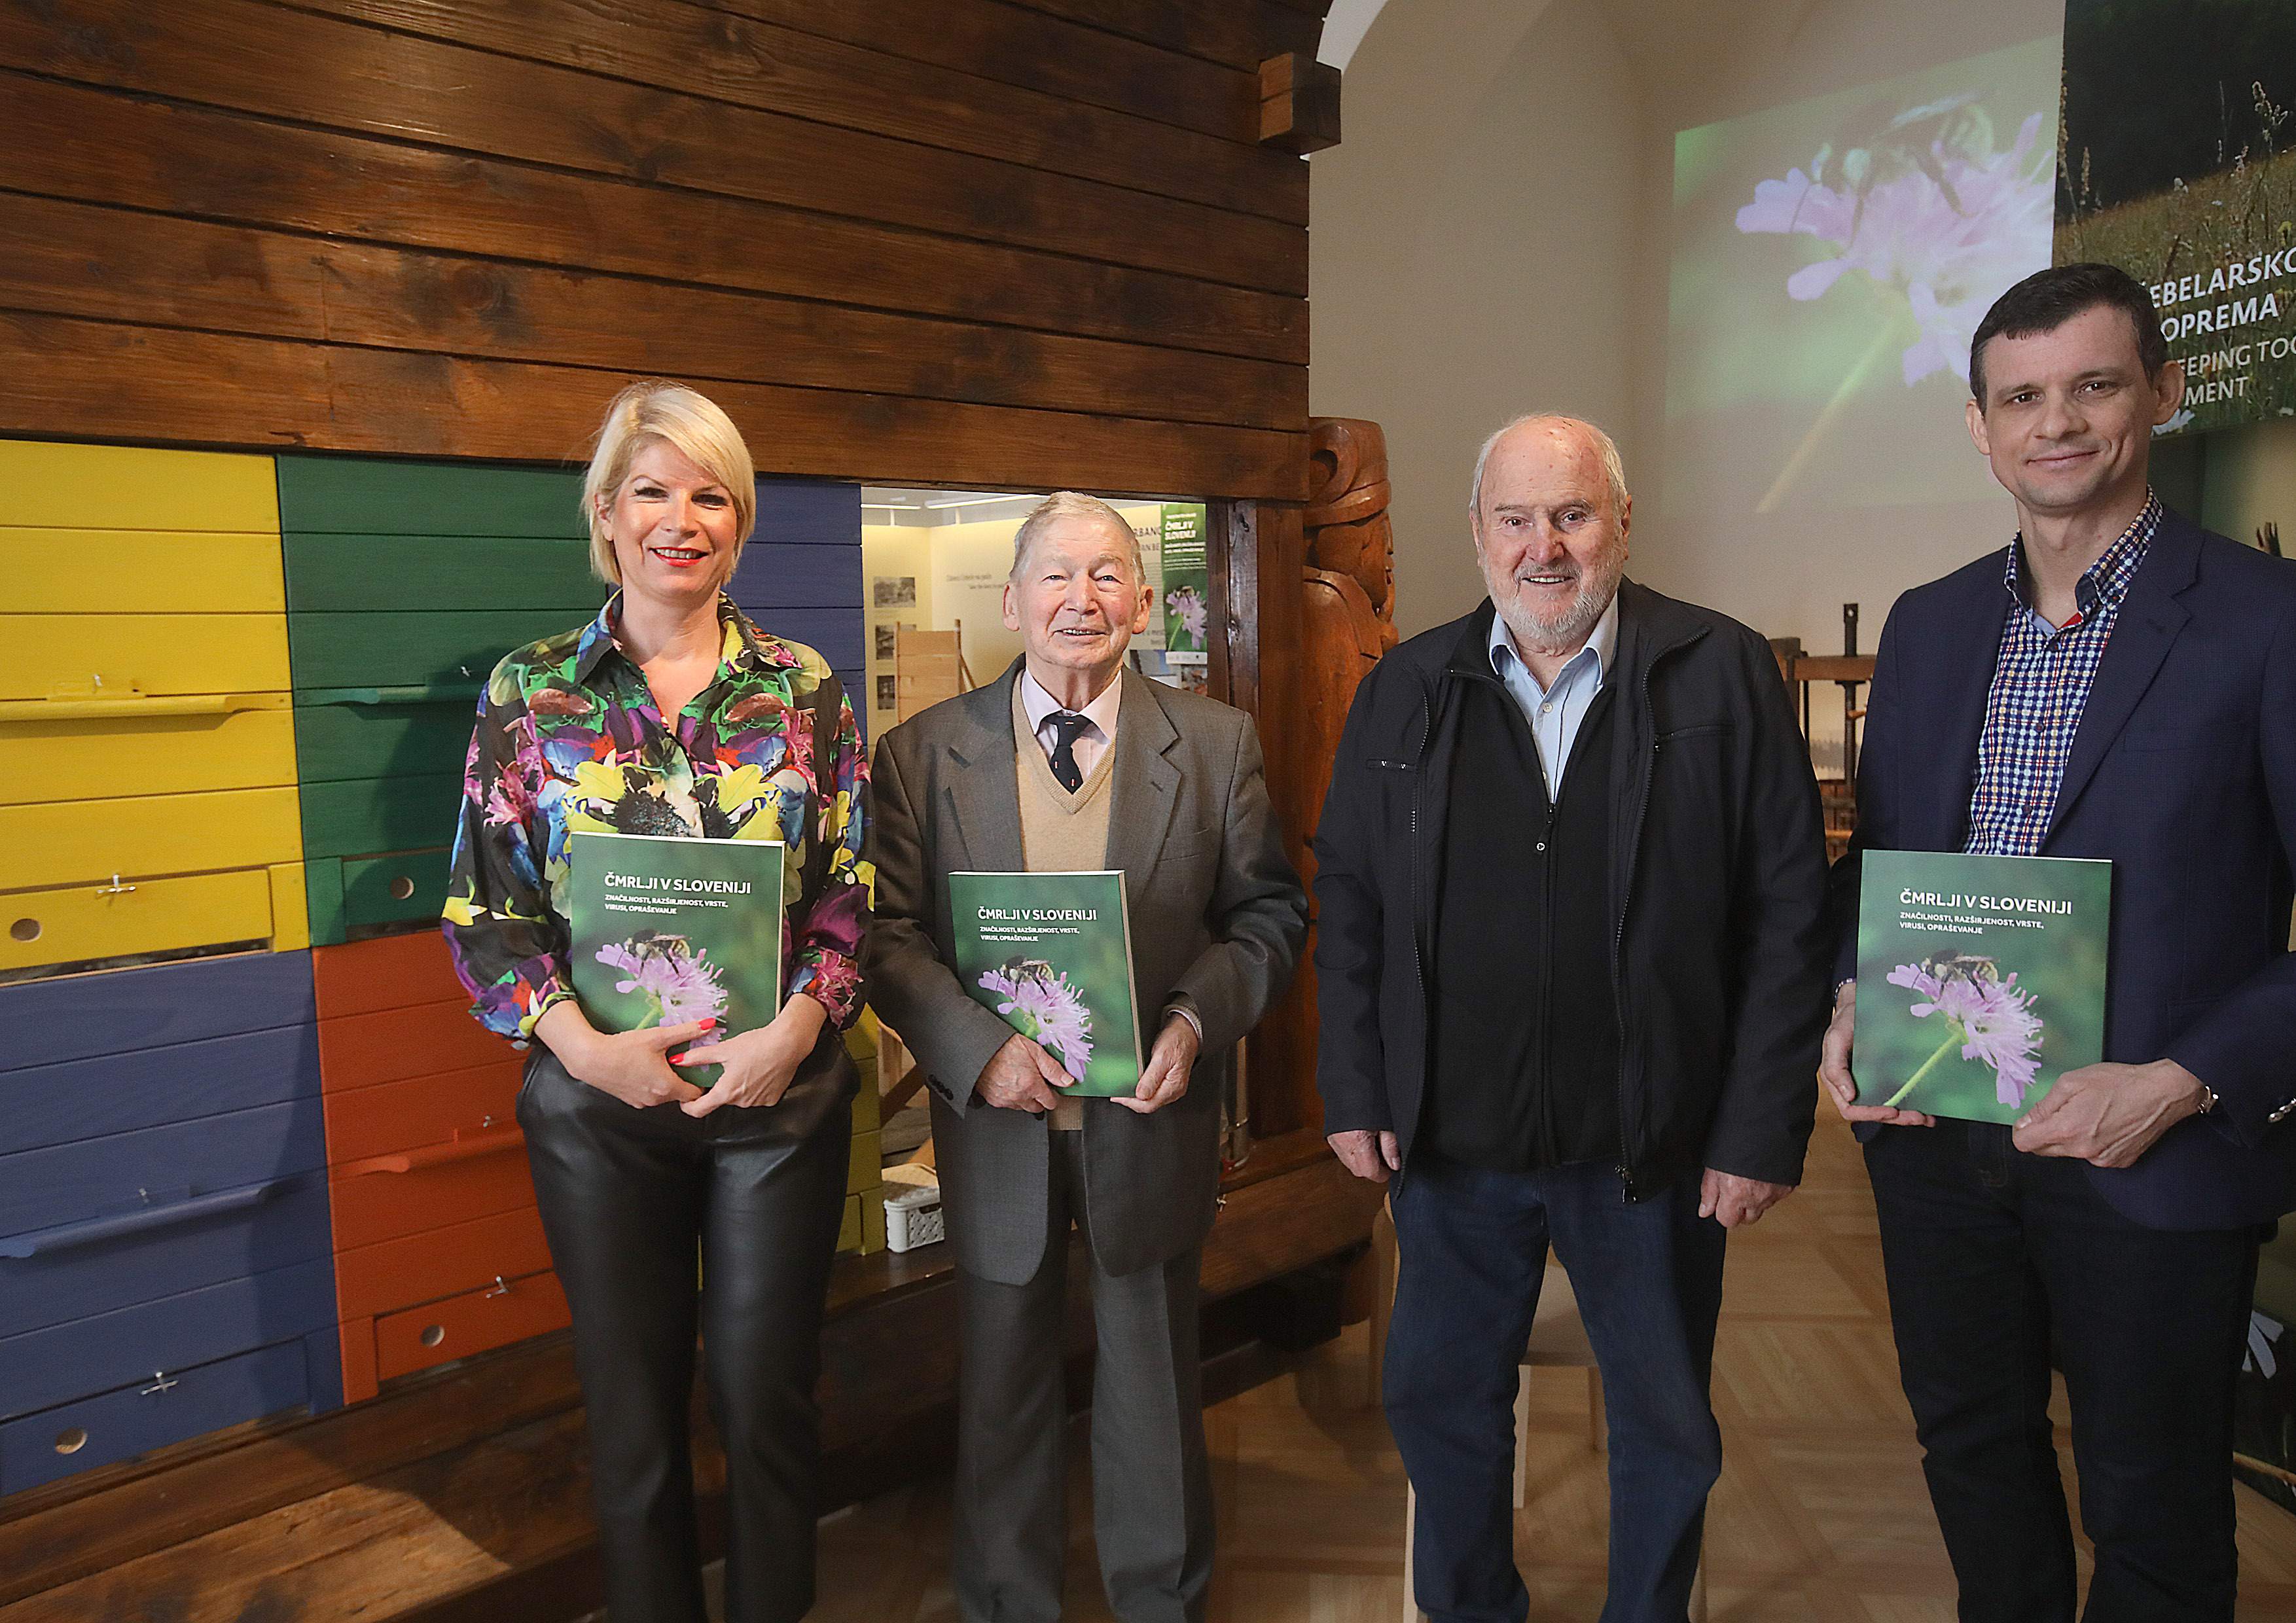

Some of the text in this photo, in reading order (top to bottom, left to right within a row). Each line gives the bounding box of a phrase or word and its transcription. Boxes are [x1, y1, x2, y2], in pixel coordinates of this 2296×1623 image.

[2139, 247, 2296, 308] EBELARSKO
[2161, 293, 2279, 342] OPREMA
[605, 872, 751, 894] ČMRLJI V SLOVENIJI
[1900, 887, 2072, 915] ČMRLJI V SLOVENIJI
[978, 906, 1097, 920] ČMRLJI V SLOVENIJI
[1900, 912, 2044, 929] ZNAČILNOSTI, RAZŠIRJENOST, VRSTE,
[1900, 922, 1982, 935] VIRUSI, OPRAŠEVANJE
